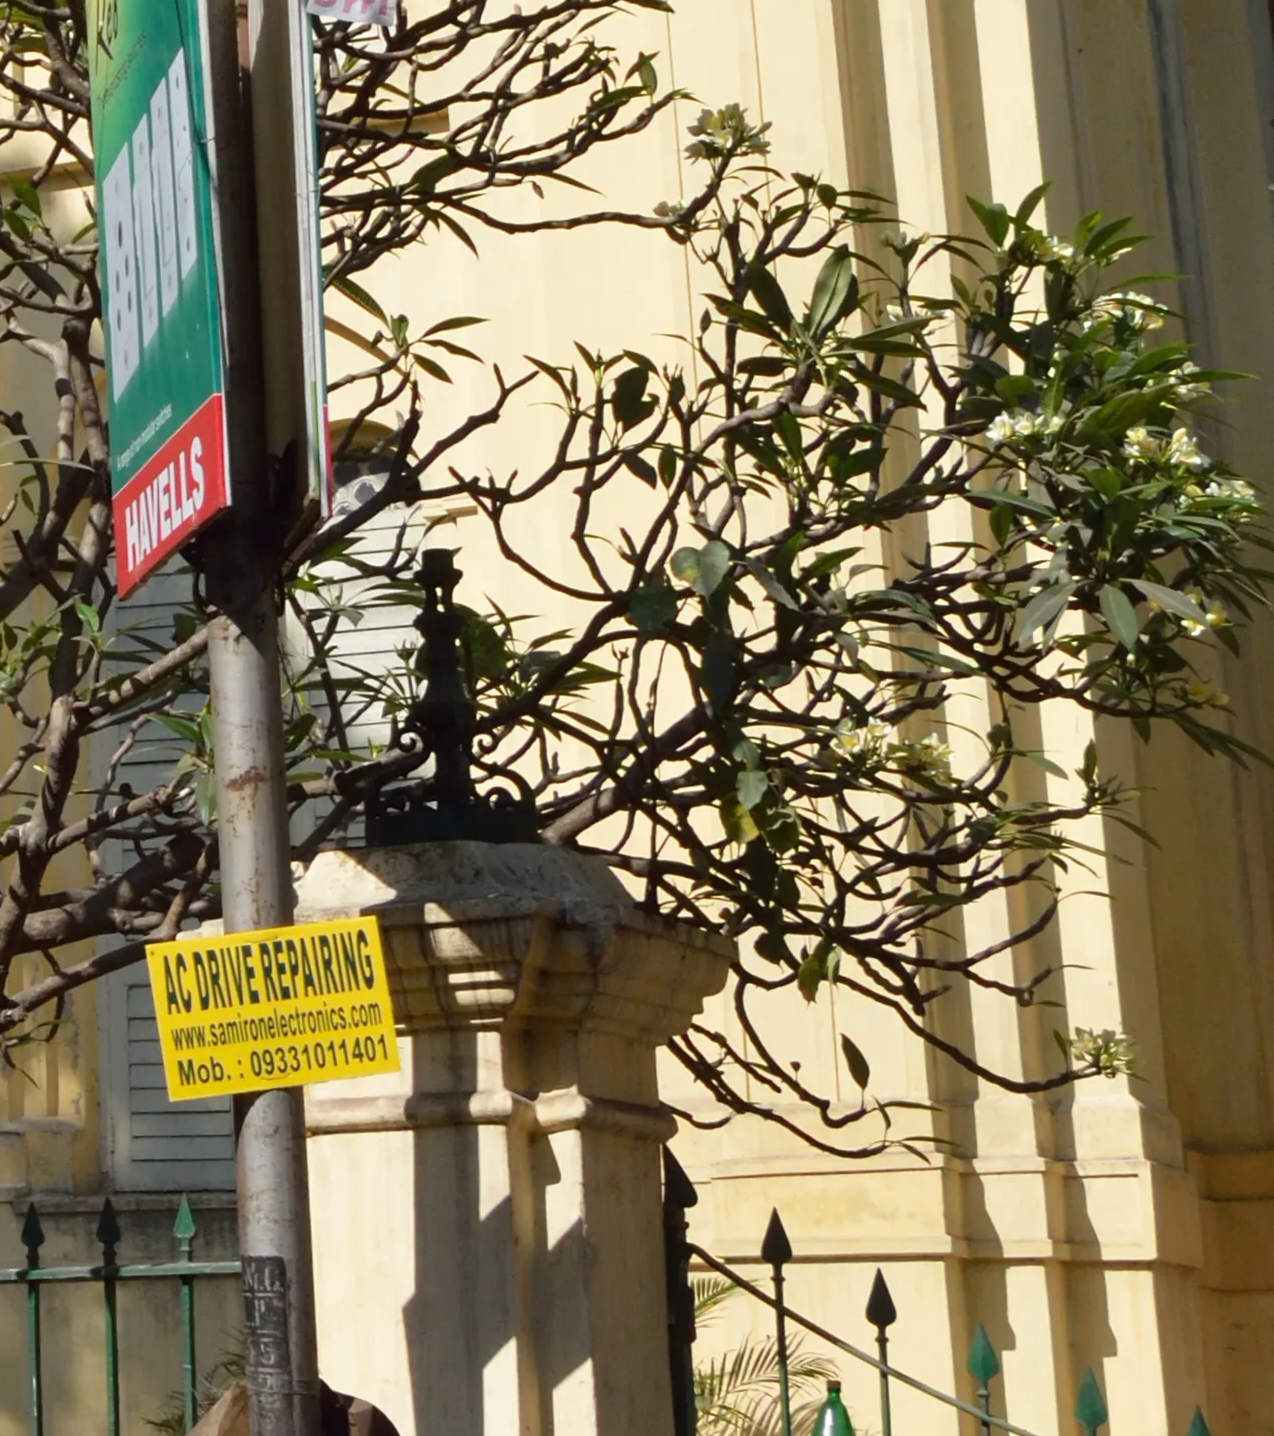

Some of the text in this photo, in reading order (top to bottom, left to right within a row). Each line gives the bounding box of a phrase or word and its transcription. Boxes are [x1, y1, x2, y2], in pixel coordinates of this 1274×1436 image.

[125, 435, 206, 573] HAVELLS
[163, 929, 375, 1015] AC DRIVE REPAIRING
[171, 1001, 383, 1051] www.samironelectronics.com
[250, 1034, 389, 1077] 09331011401
